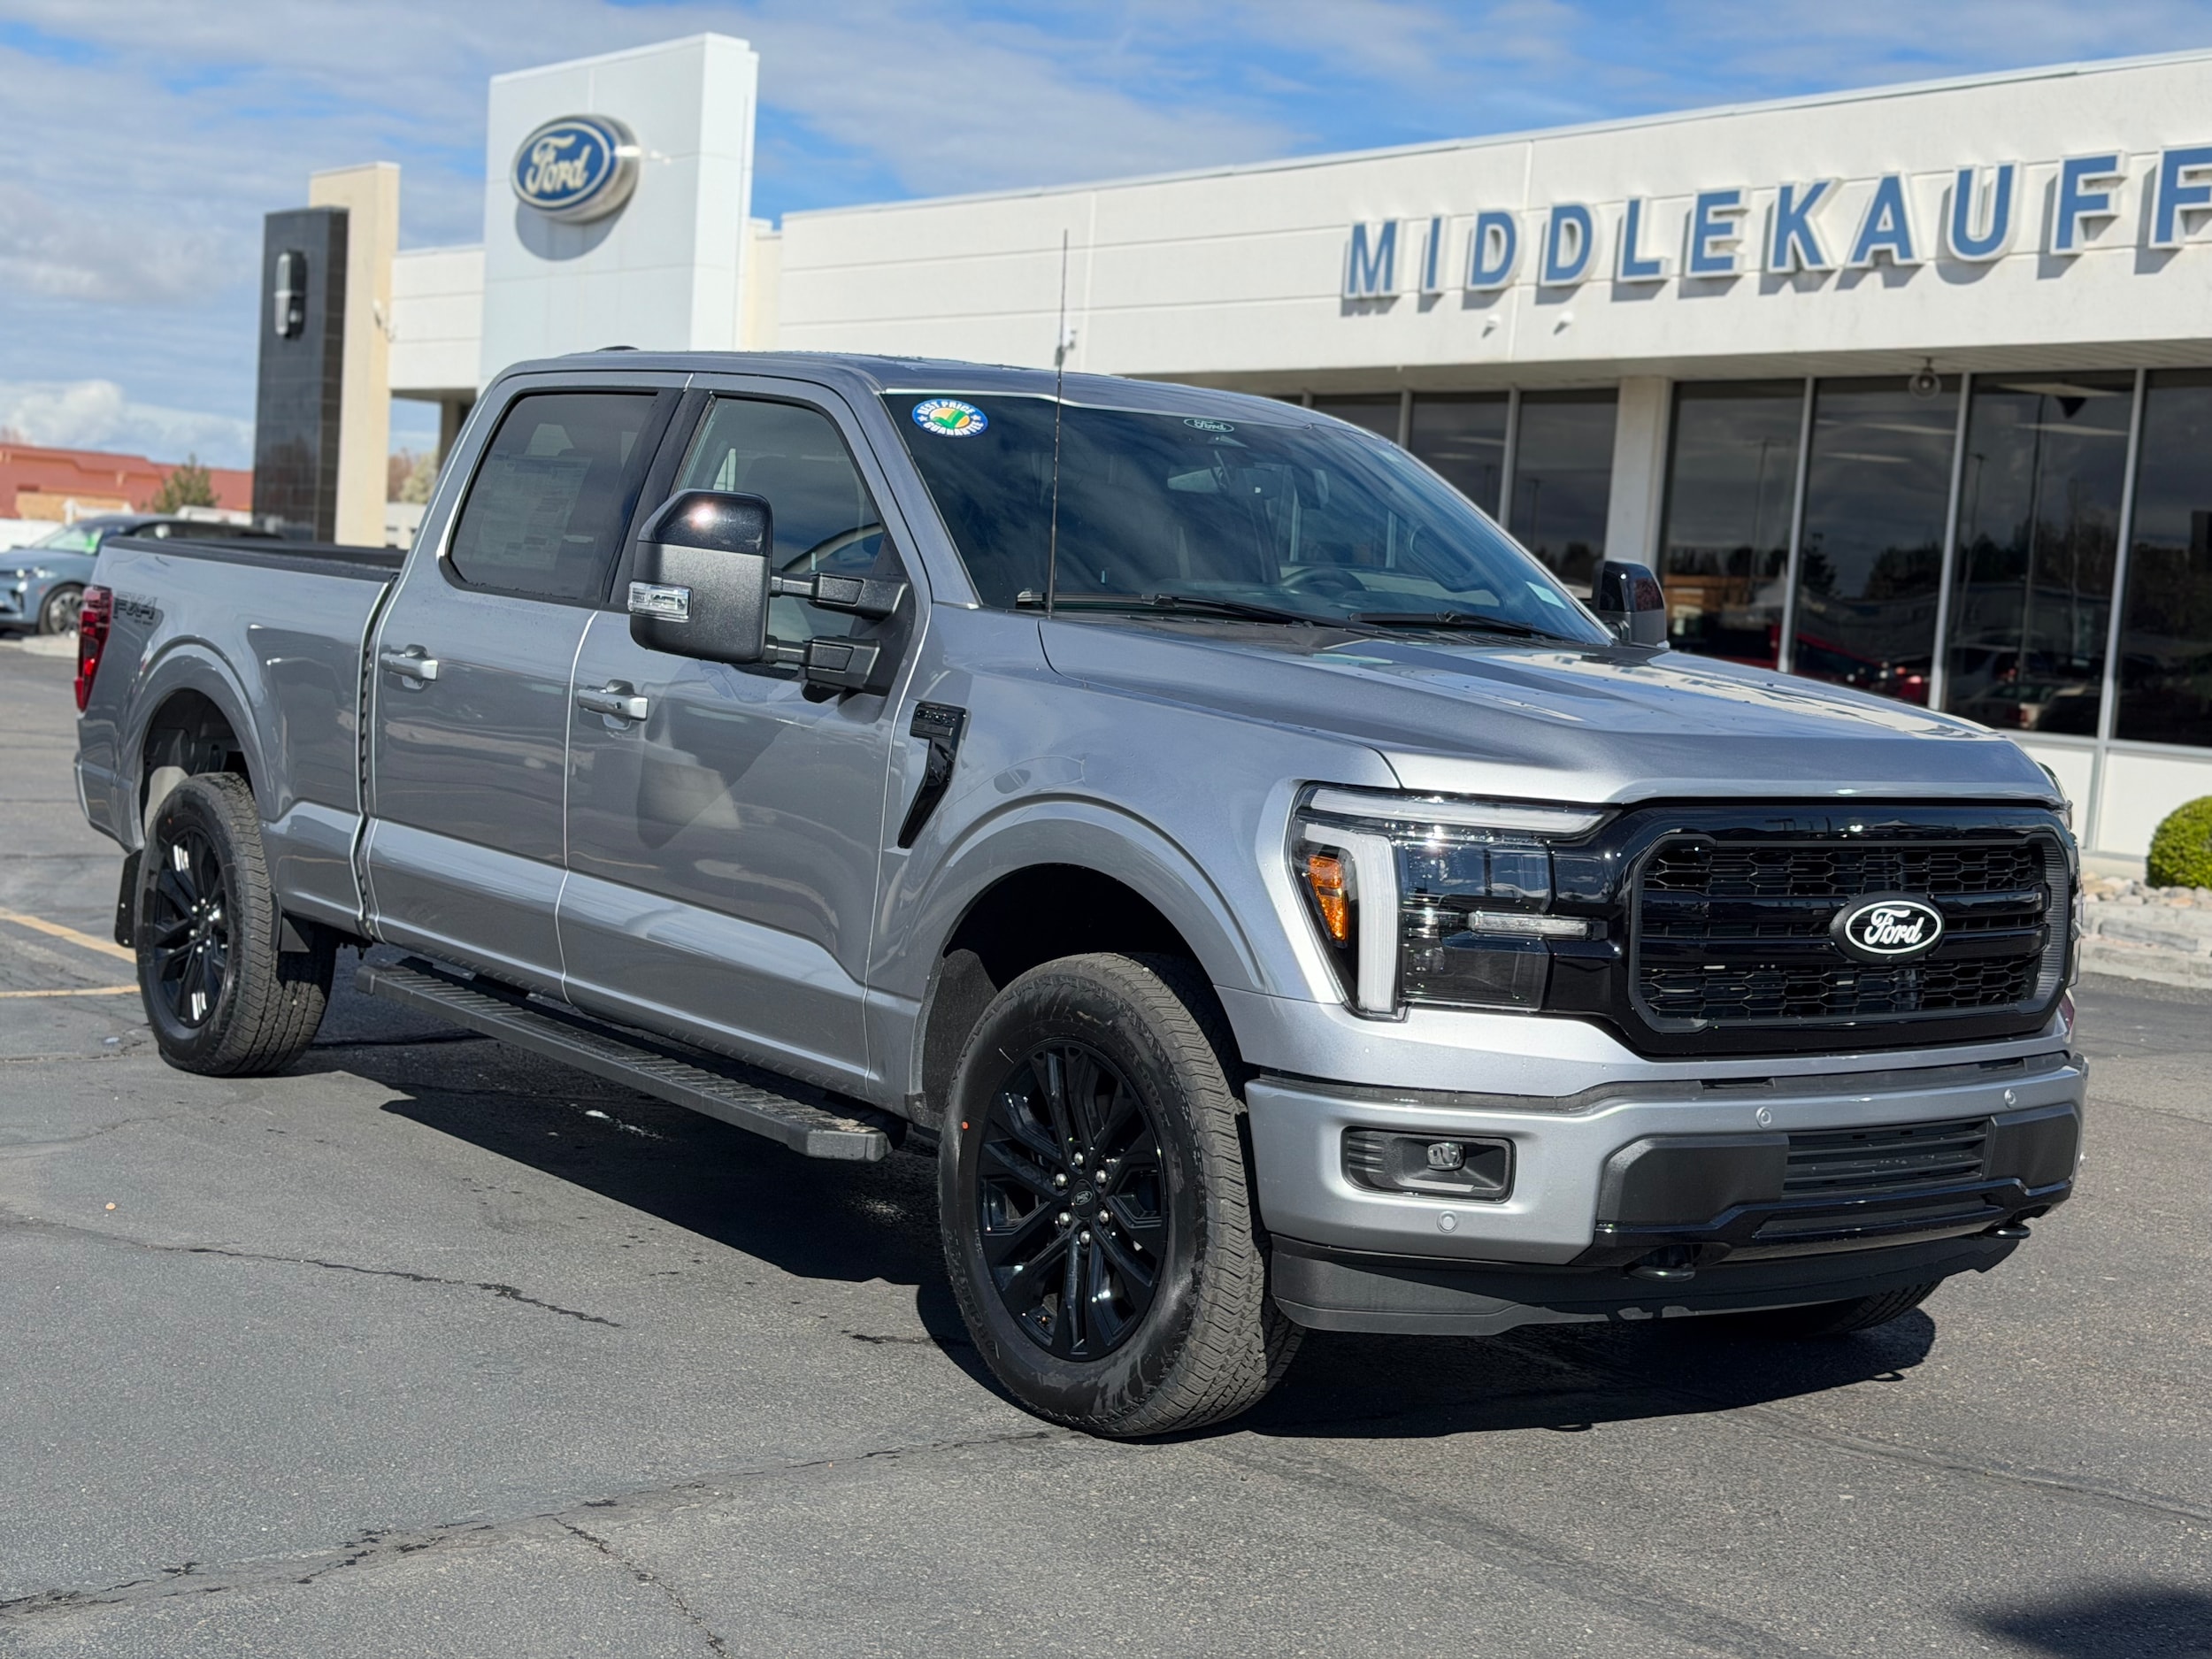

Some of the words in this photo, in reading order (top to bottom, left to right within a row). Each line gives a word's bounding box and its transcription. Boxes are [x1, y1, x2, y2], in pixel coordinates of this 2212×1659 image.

[526, 134, 592, 196] Ford
[1344, 144, 2212, 299] MIDDLEKAUFF
[917, 401, 940, 416] BEST
[941, 401, 976, 415] PRICE
[1193, 419, 1226, 431] Ford
[1863, 908, 1925, 945] Ford
